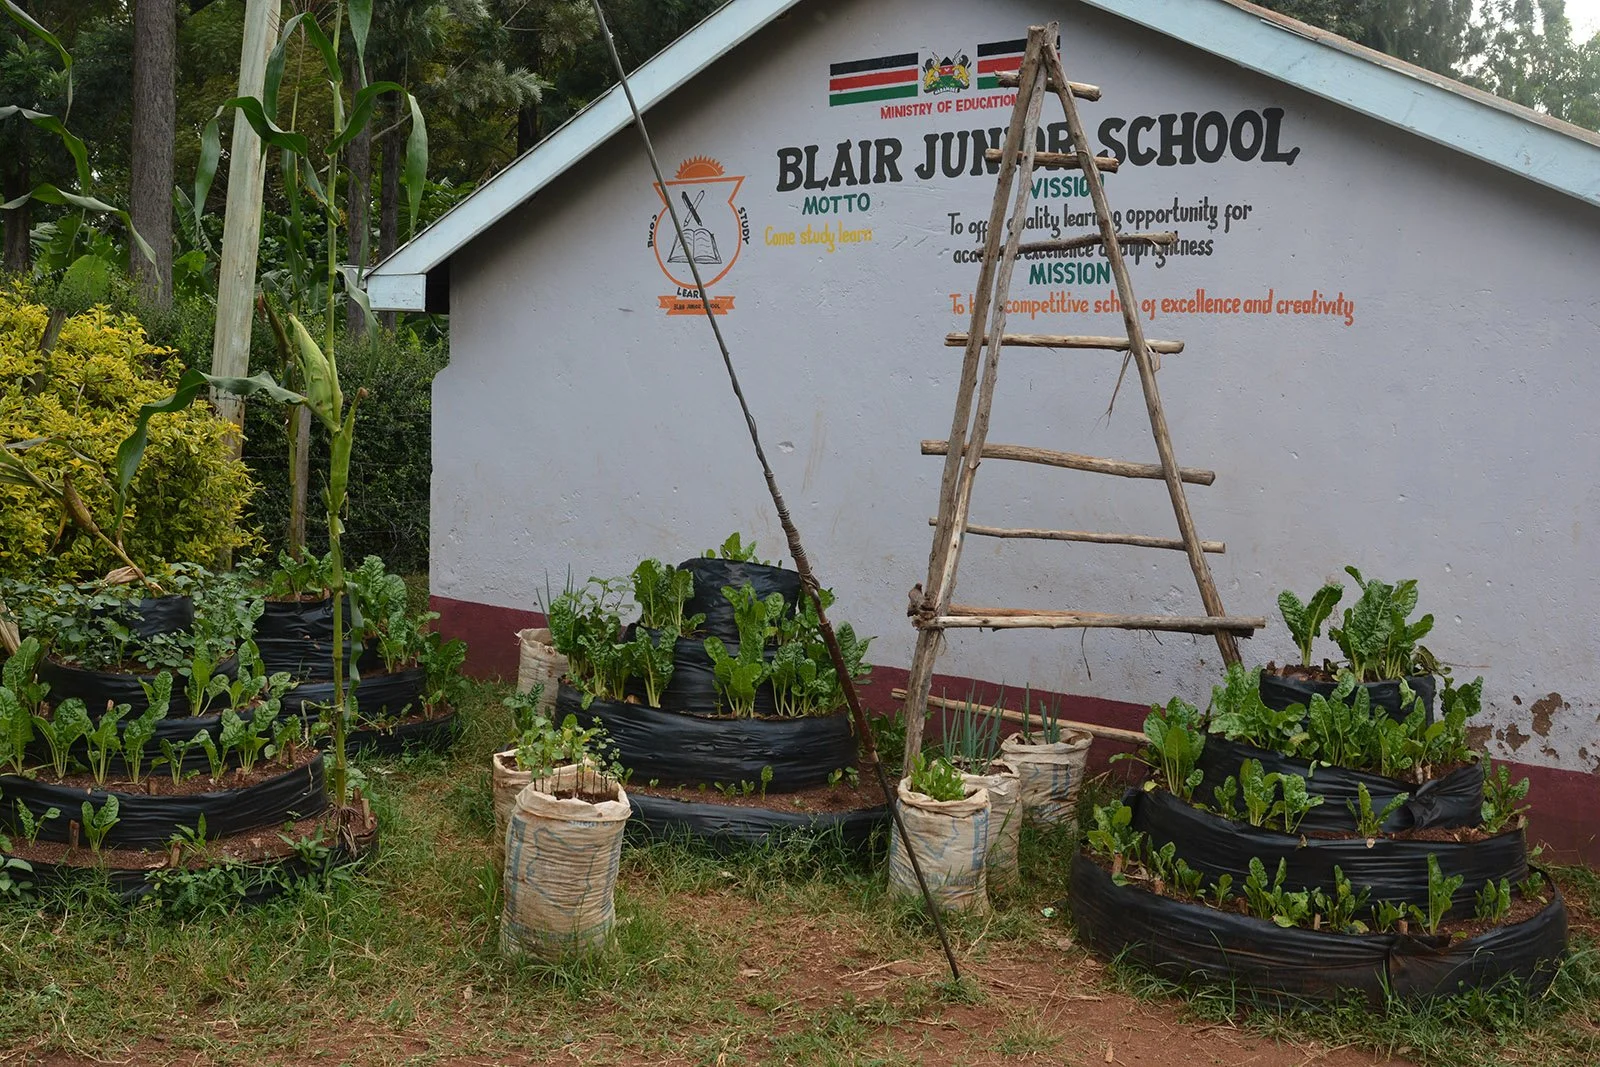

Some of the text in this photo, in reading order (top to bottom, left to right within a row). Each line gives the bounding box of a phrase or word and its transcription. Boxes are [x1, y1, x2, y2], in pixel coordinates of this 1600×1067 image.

[880, 102, 932, 119] MINISTRY
[937, 101, 952, 113] OF
[776, 107, 1300, 192] BLAIR JUNR SCHOOL
[1031, 174, 1105, 199] VISSIO
[802, 192, 870, 215] MOTTO
[738, 206, 750, 245] STUDY
[948, 212, 963, 235] To
[968, 220, 989, 244] off
[1064, 203, 1122, 233] learng
[1126, 196, 1218, 230] opportunity
[1224, 203, 1252, 233] for
[764, 219, 873, 254] Come study learn
[1029, 261, 1111, 285] MISSION
[677, 287, 703, 299] LEAR
[949, 294, 964, 315] To
[1006, 290, 1089, 320] competitive
[1094, 289, 1128, 313] sch
[1142, 298, 1156, 320] of
[1161, 289, 1240, 314] excellence
[1243, 289, 1273, 314] and
[1276, 290, 1354, 326] creativity
